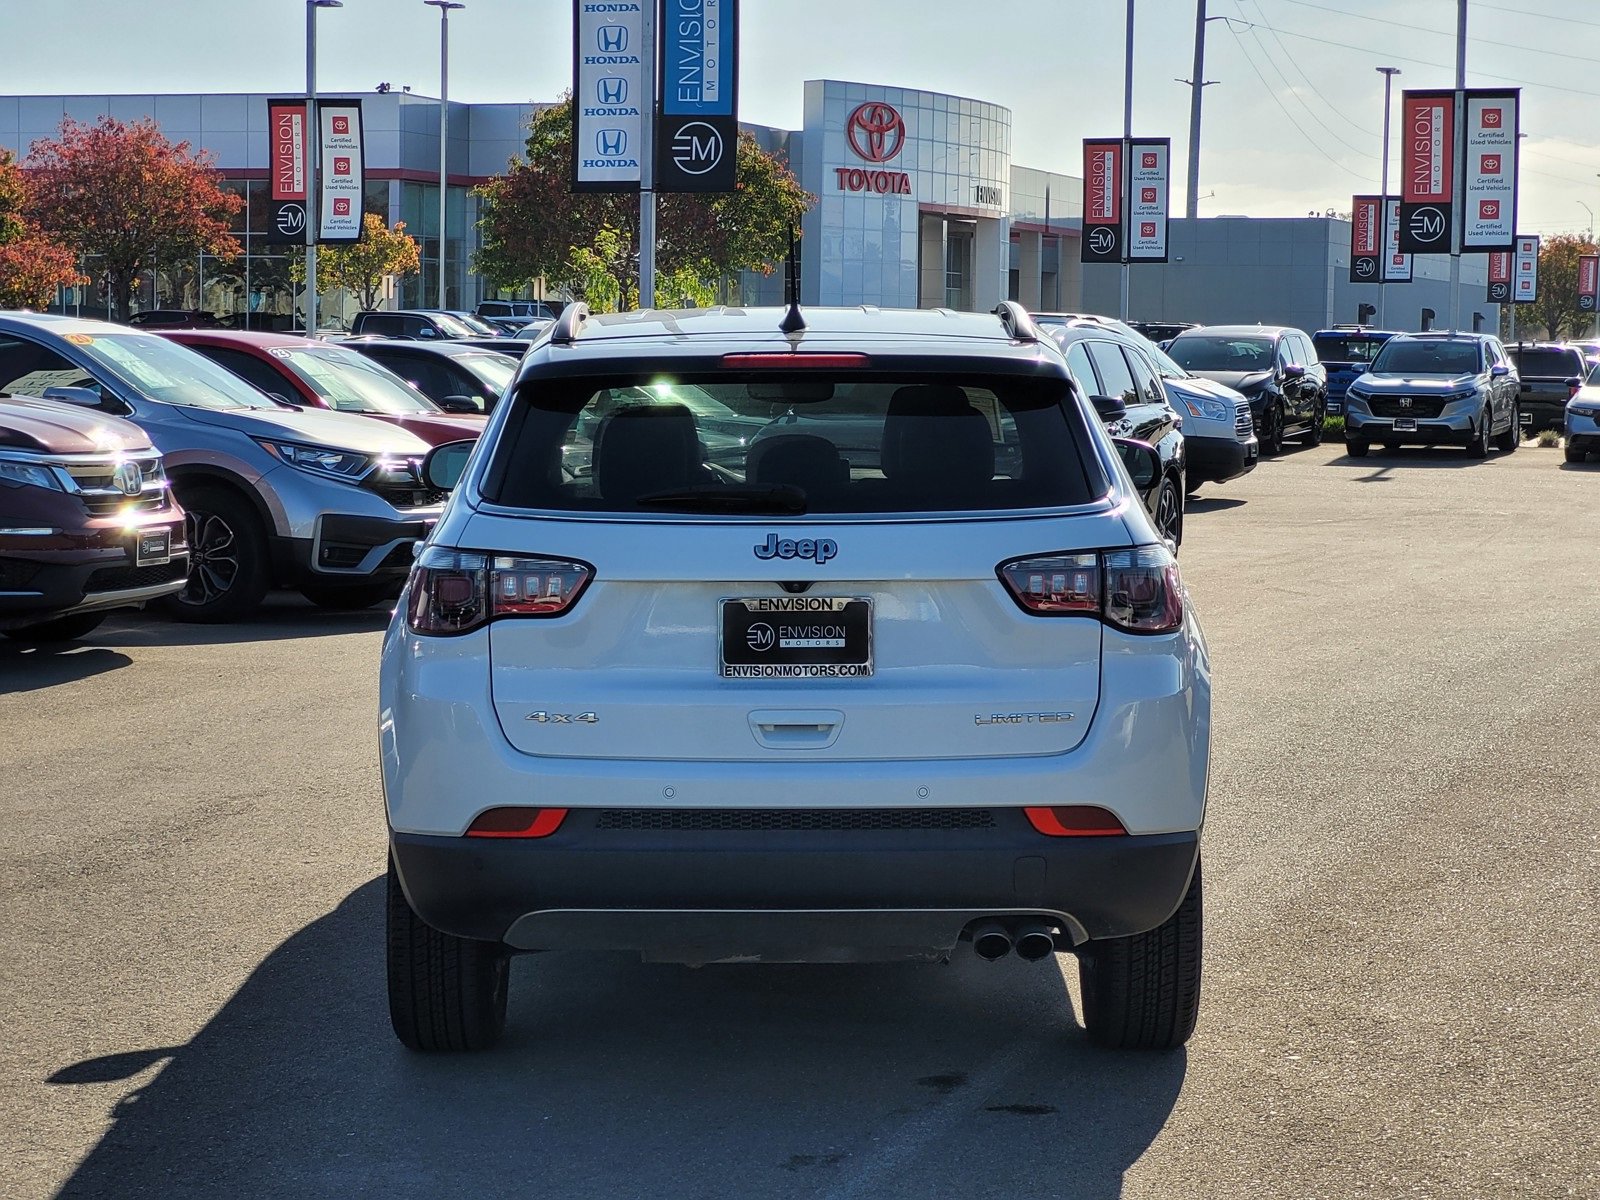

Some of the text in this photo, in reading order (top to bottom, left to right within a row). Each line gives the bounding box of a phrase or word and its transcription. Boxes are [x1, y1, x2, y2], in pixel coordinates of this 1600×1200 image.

[584, 4, 640, 12] HONDA
[679, 0, 701, 102] ENVISIO
[707, 0, 716, 91] MOTOR
[584, 56, 640, 64] HONDA
[583, 108, 640, 116] HONDA
[278, 114, 293, 193] ENVISION
[1414, 106, 1431, 195] ENVISION
[582, 159, 639, 168] HONDA
[834, 168, 912, 195] TOYOTA
[1092, 151, 1105, 218] ENVISION
[1358, 204, 1368, 252] ENVISION
[1493, 253, 1501, 279] ENVISI
[754, 533, 838, 564] Jeep
[758, 599, 833, 611] ENVISION
[779, 626, 846, 638] ENVISION
[724, 665, 868, 677] ENVISIONMOTORS.COM
[525, 710, 600, 724] 4x4
[974, 711, 1075, 726] LIMITED
